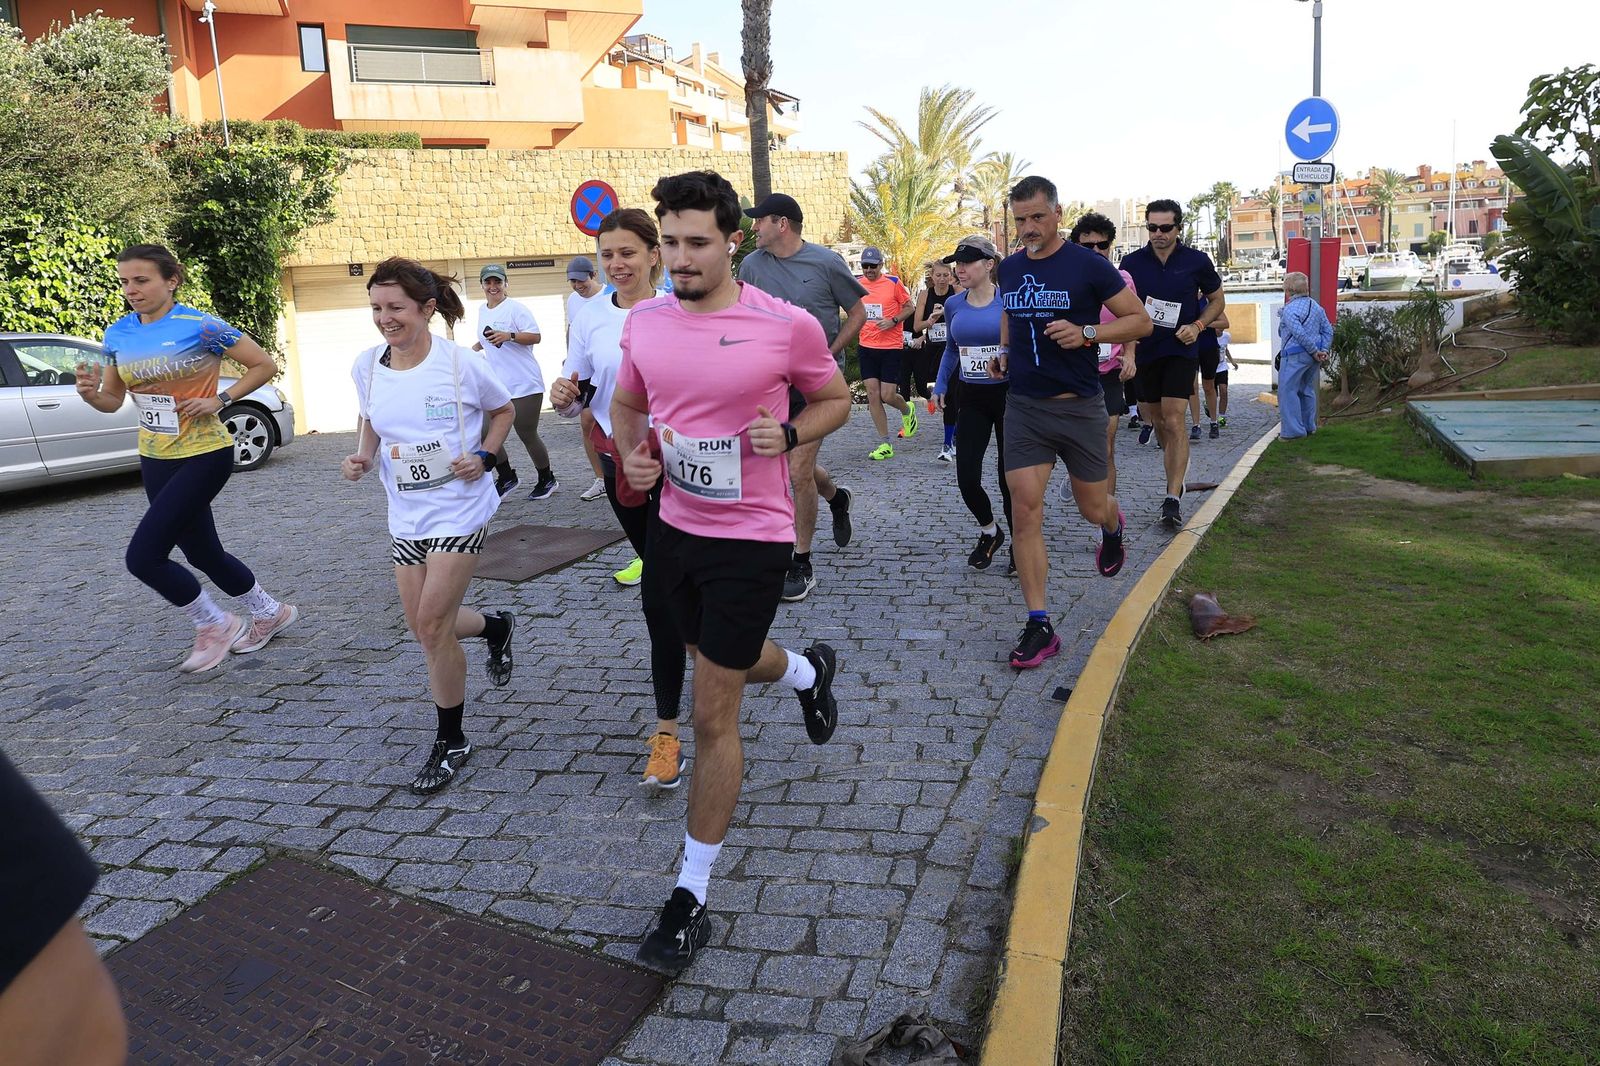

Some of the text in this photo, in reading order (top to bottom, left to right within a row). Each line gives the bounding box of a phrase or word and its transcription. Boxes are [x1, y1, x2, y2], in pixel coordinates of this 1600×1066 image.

[1037, 292, 1067, 300] SIERRA
[1153, 310, 1165, 320] 73
[151, 396, 171, 404] RUN
[425, 406, 454, 417] RUN
[416, 440, 440, 453] RUN
[698, 439, 732, 452] RUN
[410, 464, 430, 481] 88
[678, 459, 713, 486] 176
